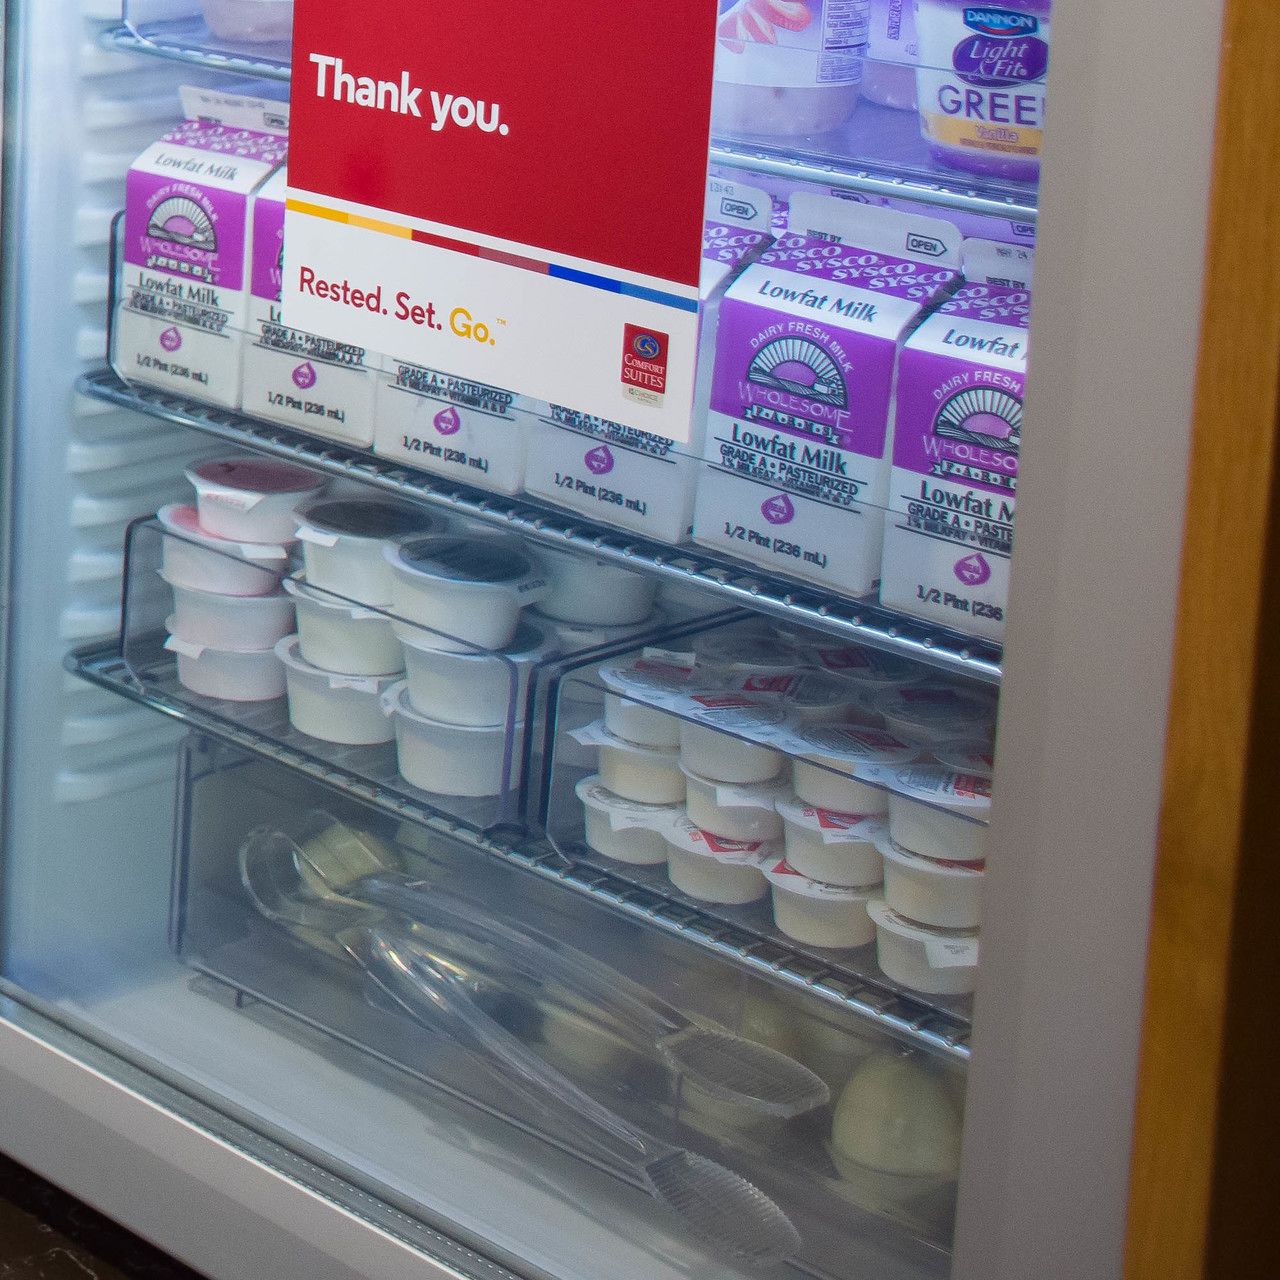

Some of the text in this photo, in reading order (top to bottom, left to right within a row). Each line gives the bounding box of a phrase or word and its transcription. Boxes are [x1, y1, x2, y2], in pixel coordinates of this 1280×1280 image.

[967, 10, 1034, 29] DANNON
[969, 40, 1029, 64] Light
[992, 58, 1022, 78] Fit
[310, 53, 509, 135] Thank you.
[938, 84, 1045, 126] GREE
[153, 153, 238, 181] Lowfat Milk
[724, 203, 749, 216] OPEN
[760, 246, 842, 264] SYSCO
[910, 237, 938, 253] OPEN
[796, 254, 880, 272] SYSCO
[831, 263, 917, 280] SYSCO
[139, 271, 220, 308] Lowfat Milk
[868, 271, 954, 289] SYSCO
[299, 266, 389, 316] Rested.
[394, 291, 443, 332] Set.
[757, 279, 879, 323] Lowfat Milk
[940, 293, 1027, 312] SYSCO
[749, 321, 855, 374] DAIRY FRESH MILK
[942, 328, 1020, 359] Lowfat
[623, 367, 665, 388] SUITES
[624, 353, 666, 375] COMFORT
[267, 391, 284, 406] 1/2
[397, 365, 429, 382] GRADE
[447, 378, 514, 406] PASTEURIZED
[933, 371, 1022, 401] DAIRY FRESH
[738, 381, 854, 433] WHOLESOME
[402, 435, 421, 452] 1/2
[422, 441, 443, 458] Pint
[731, 422, 848, 476] Lowfat Milk
[922, 434, 1019, 471] WHOLESO
[720, 444, 860, 496] GRADE A PASTEURIZED
[553, 471, 574, 489] 1/2
[575, 478, 597, 498] Pint
[597, 487, 624, 507] (236
[919, 479, 994, 519] Lowfat
[907, 501, 962, 528] GRADE A
[723, 521, 827, 569] 1/2 Pint (236 mL)
[915, 583, 1004, 621] 1/2 Pint (236
